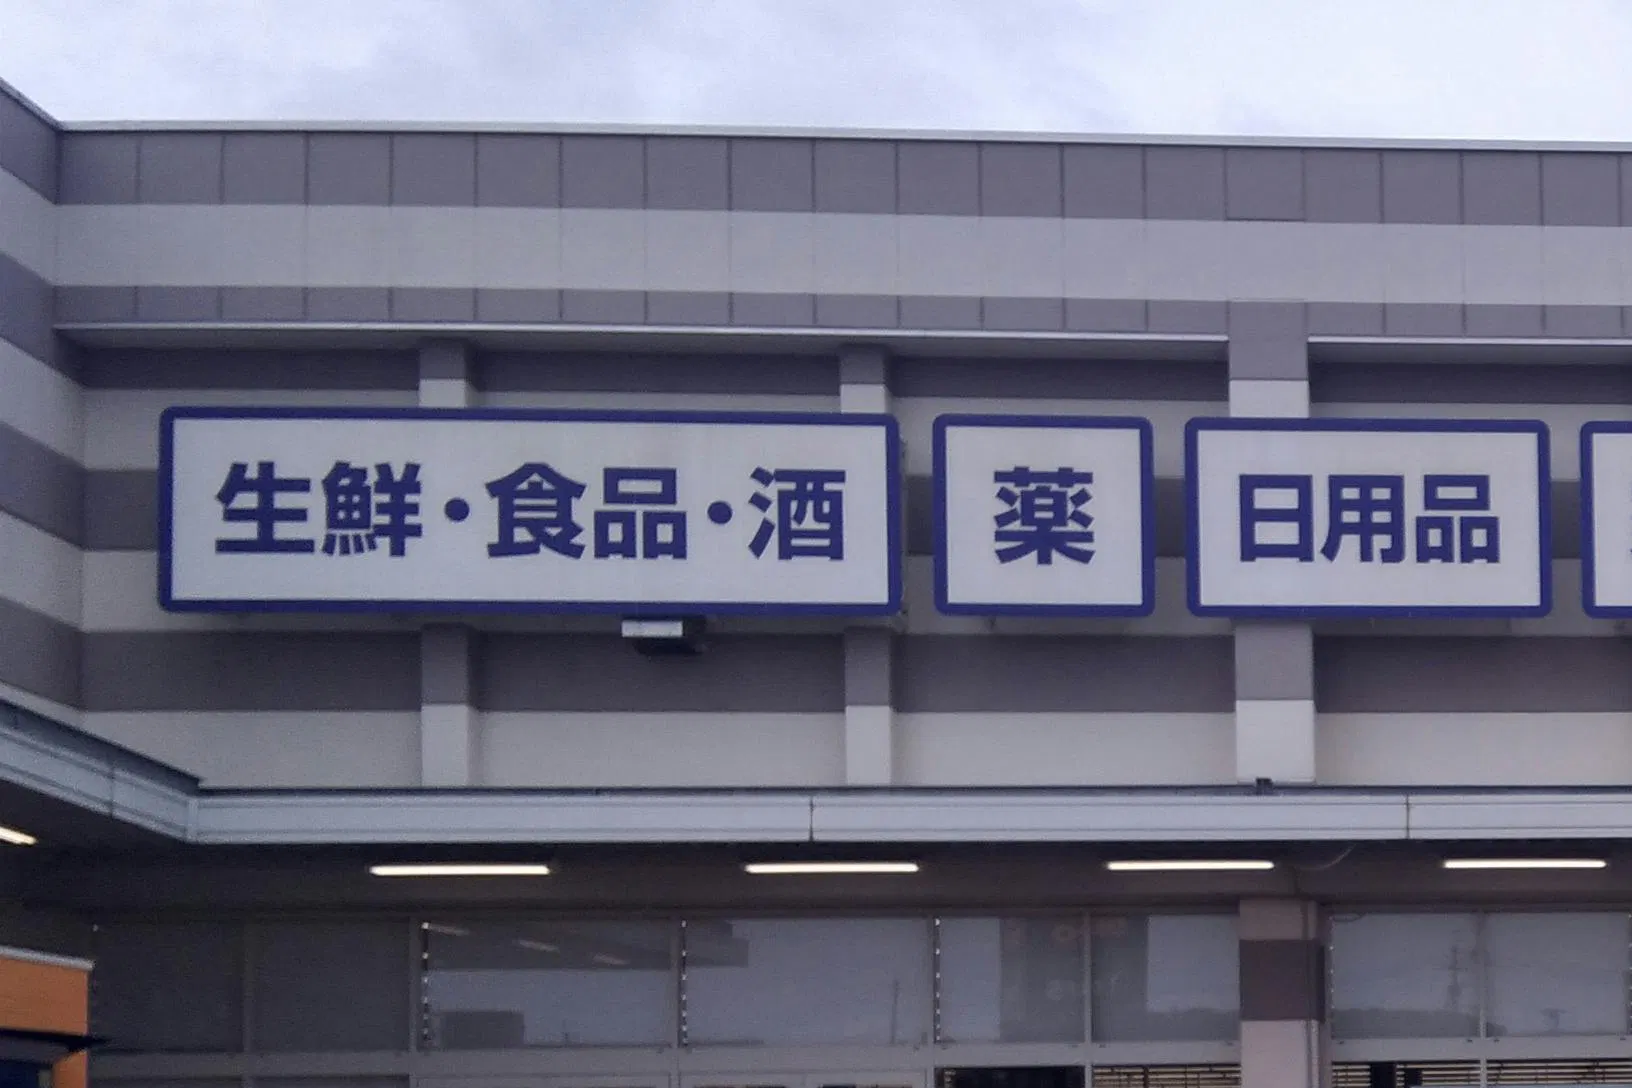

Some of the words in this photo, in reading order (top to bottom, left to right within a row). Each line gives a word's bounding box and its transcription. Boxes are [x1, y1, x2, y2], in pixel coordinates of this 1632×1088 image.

[214, 460, 846, 561] 生鮮・食品・酒
[992, 465, 1095, 565] 薬
[1238, 473, 1500, 565] 日用品
